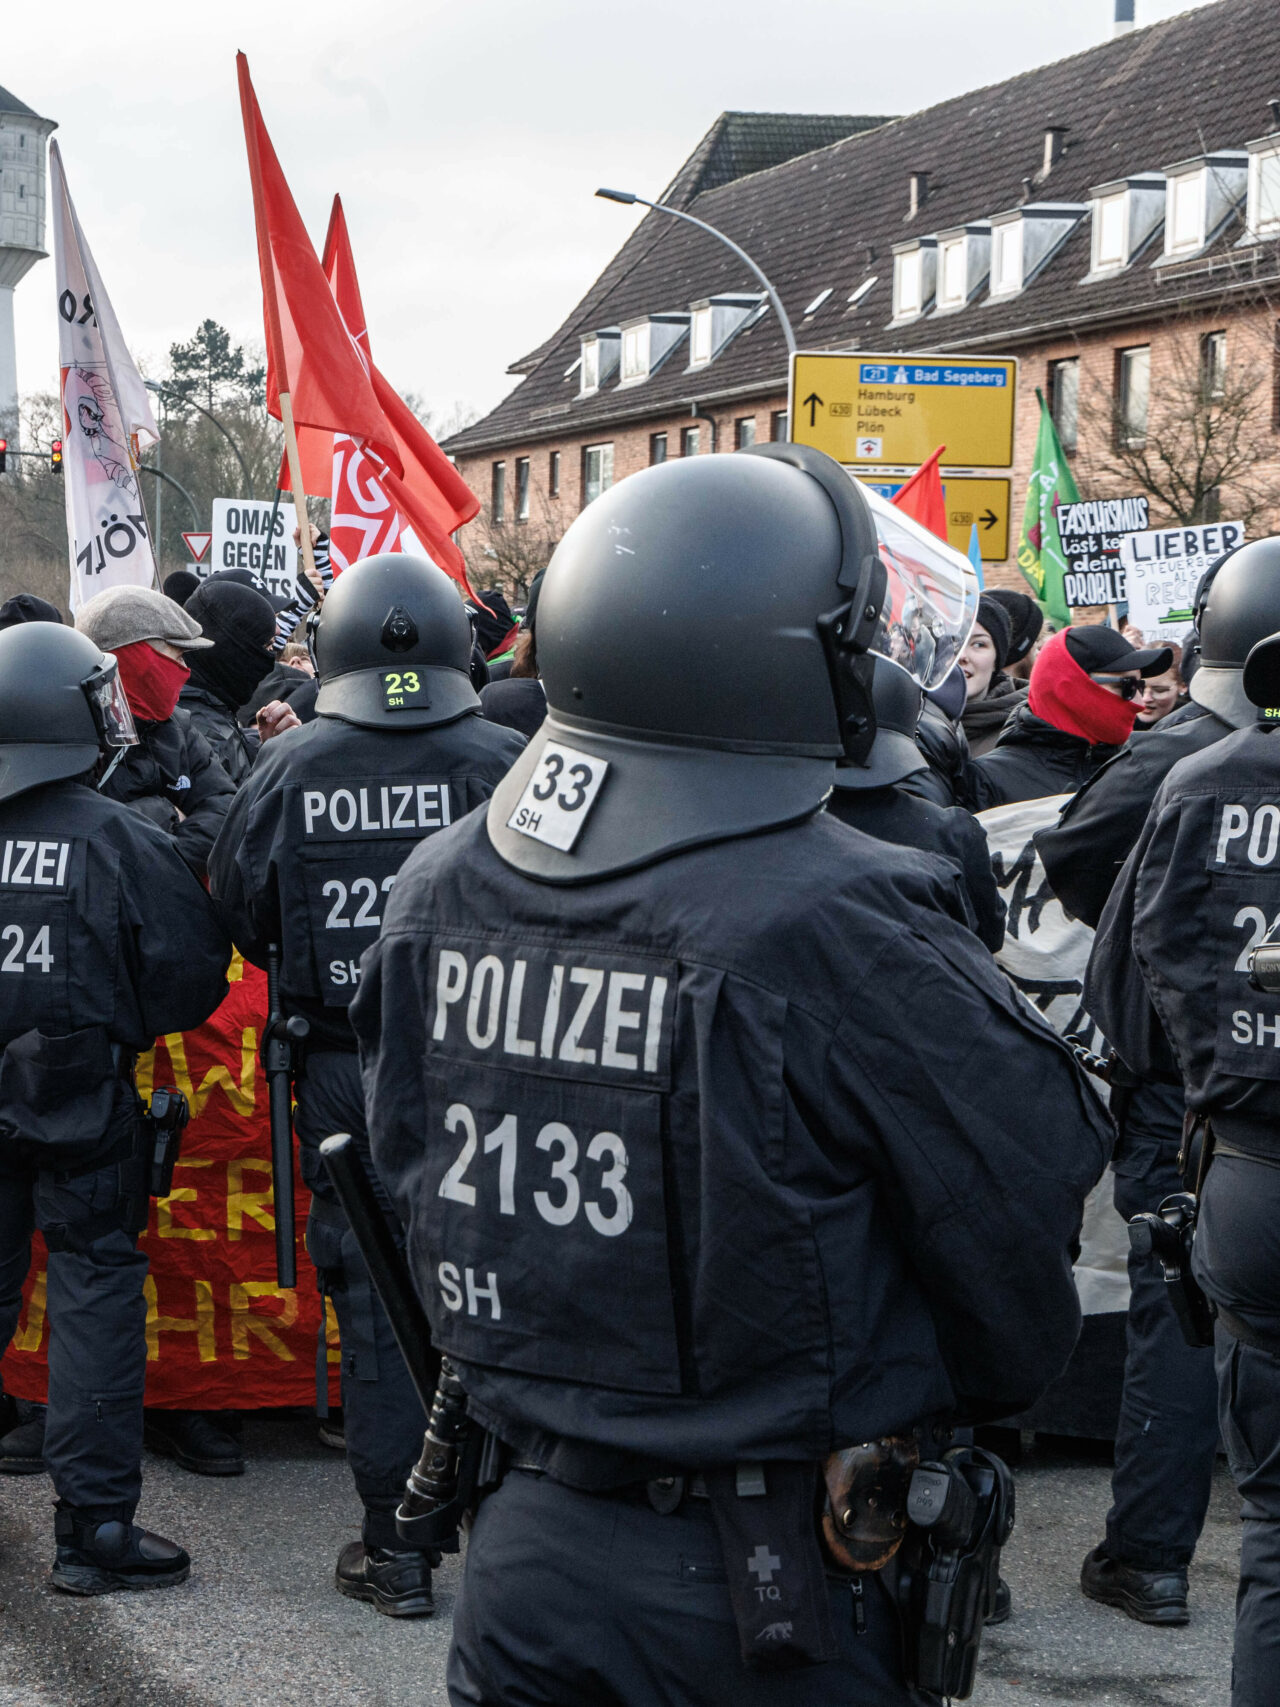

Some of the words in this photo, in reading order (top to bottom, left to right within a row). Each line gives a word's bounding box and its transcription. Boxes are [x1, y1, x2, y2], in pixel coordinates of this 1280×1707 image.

[914, 370, 939, 382] Bad
[943, 371, 1004, 386] Segeberg
[857, 389, 915, 403] Hamburg
[831, 406, 850, 415] 430
[857, 404, 902, 417] Lübeck
[856, 420, 885, 432] Plön
[226, 507, 285, 538] OMAS
[1062, 537, 1099, 554] löst
[1132, 525, 1239, 562] LIEBER
[223, 541, 286, 571] GEGEN
[1073, 556, 1125, 572] dein
[1174, 570, 1198, 582] ALS
[384, 671, 421, 695] 23
[388, 697, 404, 706] SH
[533, 753, 593, 812] 33
[303, 784, 451, 834] POLIZEI
[516, 808, 543, 833] SH
[432, 950, 668, 1073] POLIZEI
[1231, 1009, 1280, 1047] SH
[438, 1103, 634, 1237] 2133
[438, 1262, 502, 1320] SH
[754, 1585, 782, 1602] TQ
